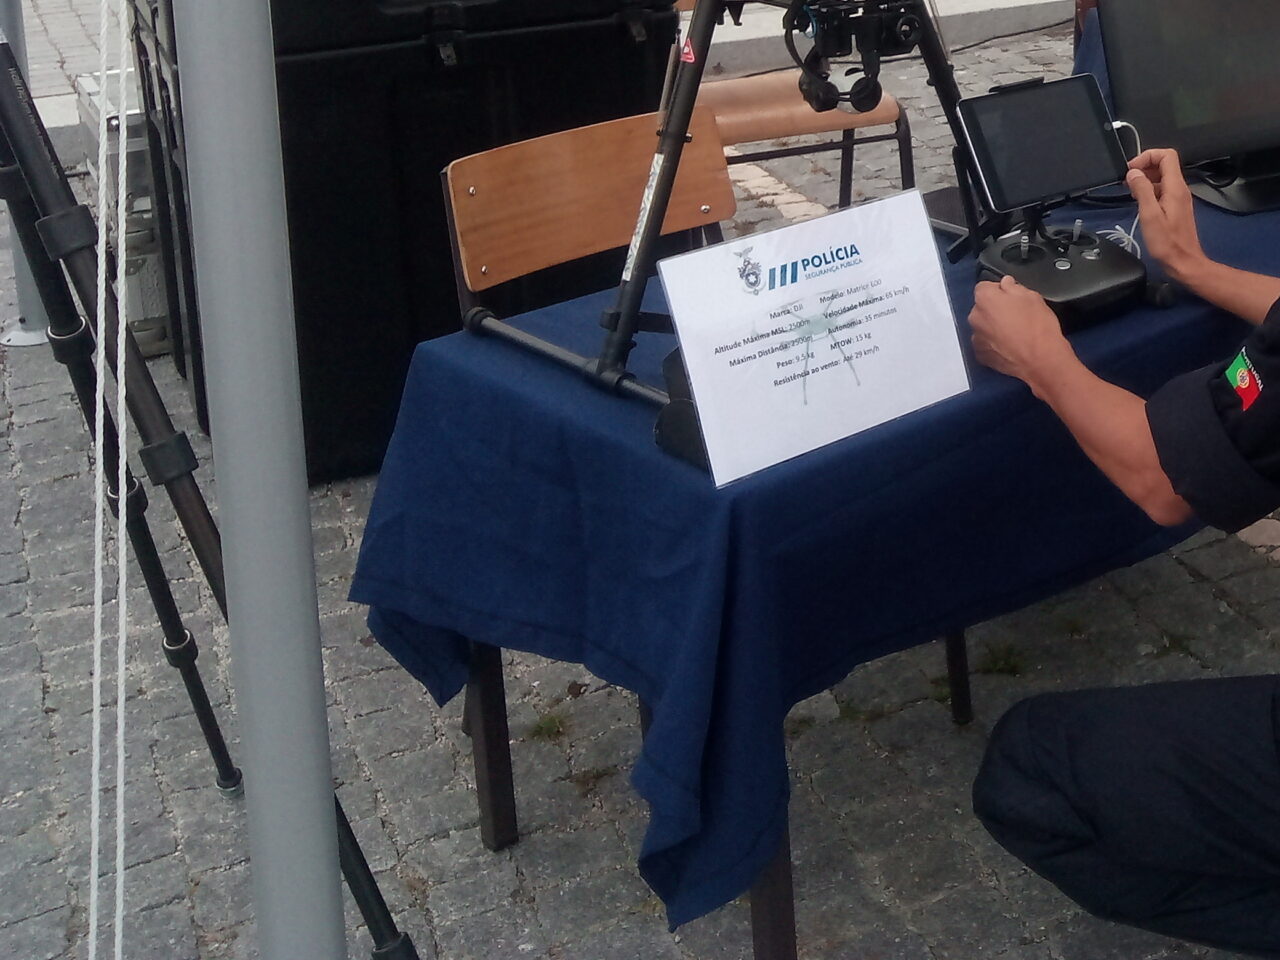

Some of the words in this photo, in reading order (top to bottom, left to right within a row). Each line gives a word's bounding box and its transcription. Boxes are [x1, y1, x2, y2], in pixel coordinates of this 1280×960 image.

[801, 244, 860, 272] POLÍCIA
[804, 266, 840, 280] SEGURANÇA
[819, 292, 845, 304] Modelo:
[769, 306, 792, 320] Marca:
[823, 303, 858, 320] Velocidade
[855, 333, 863, 343] 15
[863, 331, 872, 342] kg
[714, 340, 742, 355] Altitude
[729, 353, 757, 368] Máxima
[776, 357, 795, 369] Peso:
[811, 365, 819, 375] ao
[820, 359, 841, 372] vento:
[854, 349, 863, 360] 29
[863, 344, 880, 358] km/h
